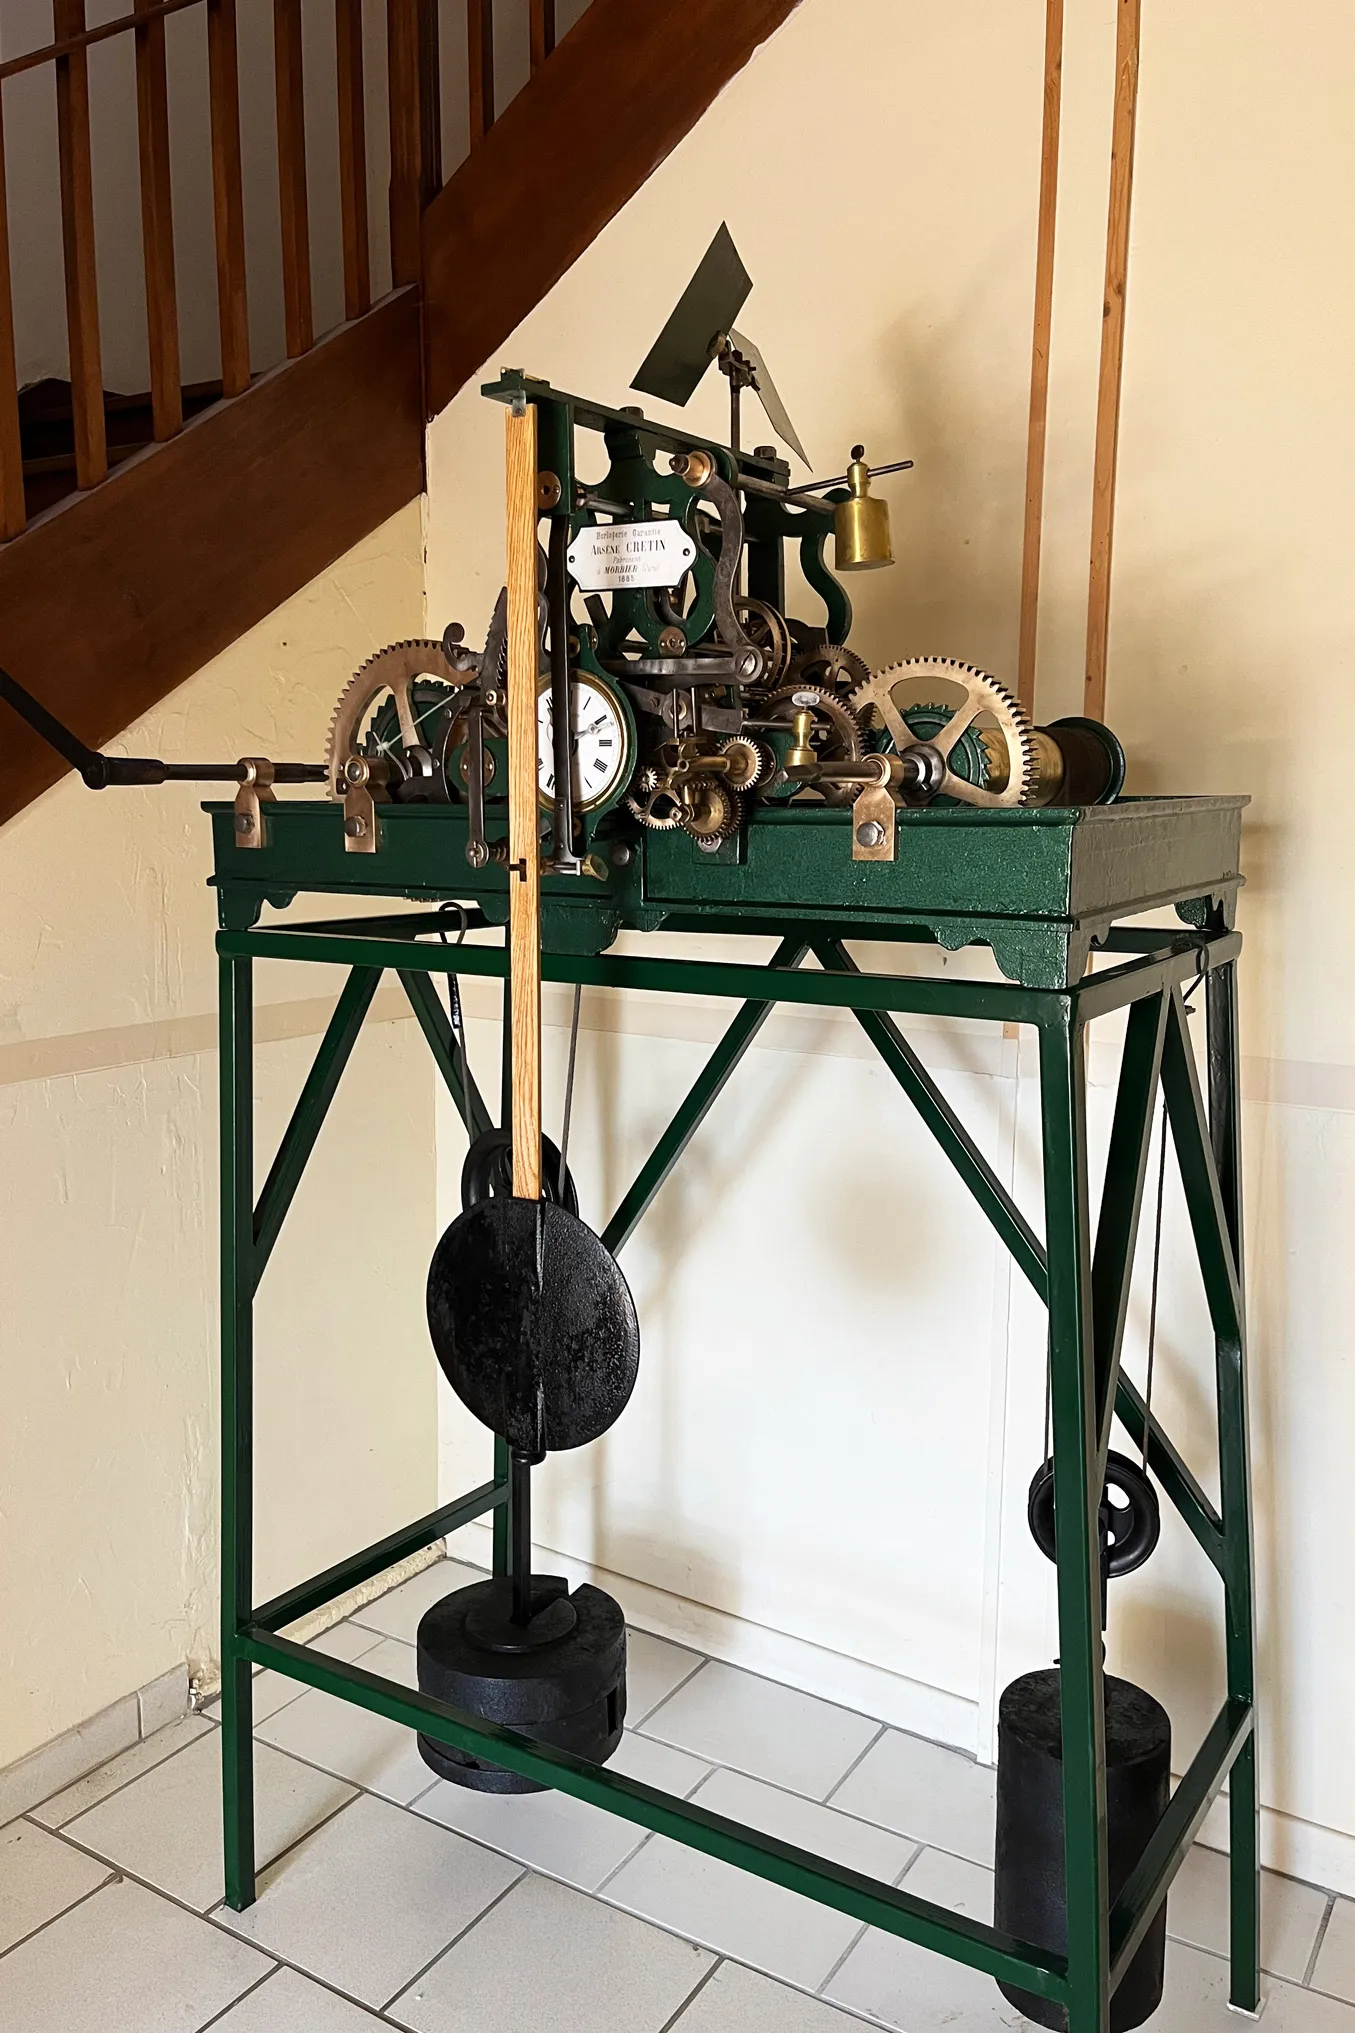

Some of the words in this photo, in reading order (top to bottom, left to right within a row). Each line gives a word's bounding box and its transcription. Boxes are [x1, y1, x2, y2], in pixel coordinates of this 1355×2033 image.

[632, 528, 661, 538] Garantie
[626, 539, 666, 553] CRETIN
[604, 564, 638, 575] MORBIER
[594, 714, 607, 726] II
[598, 739, 613, 747] III
